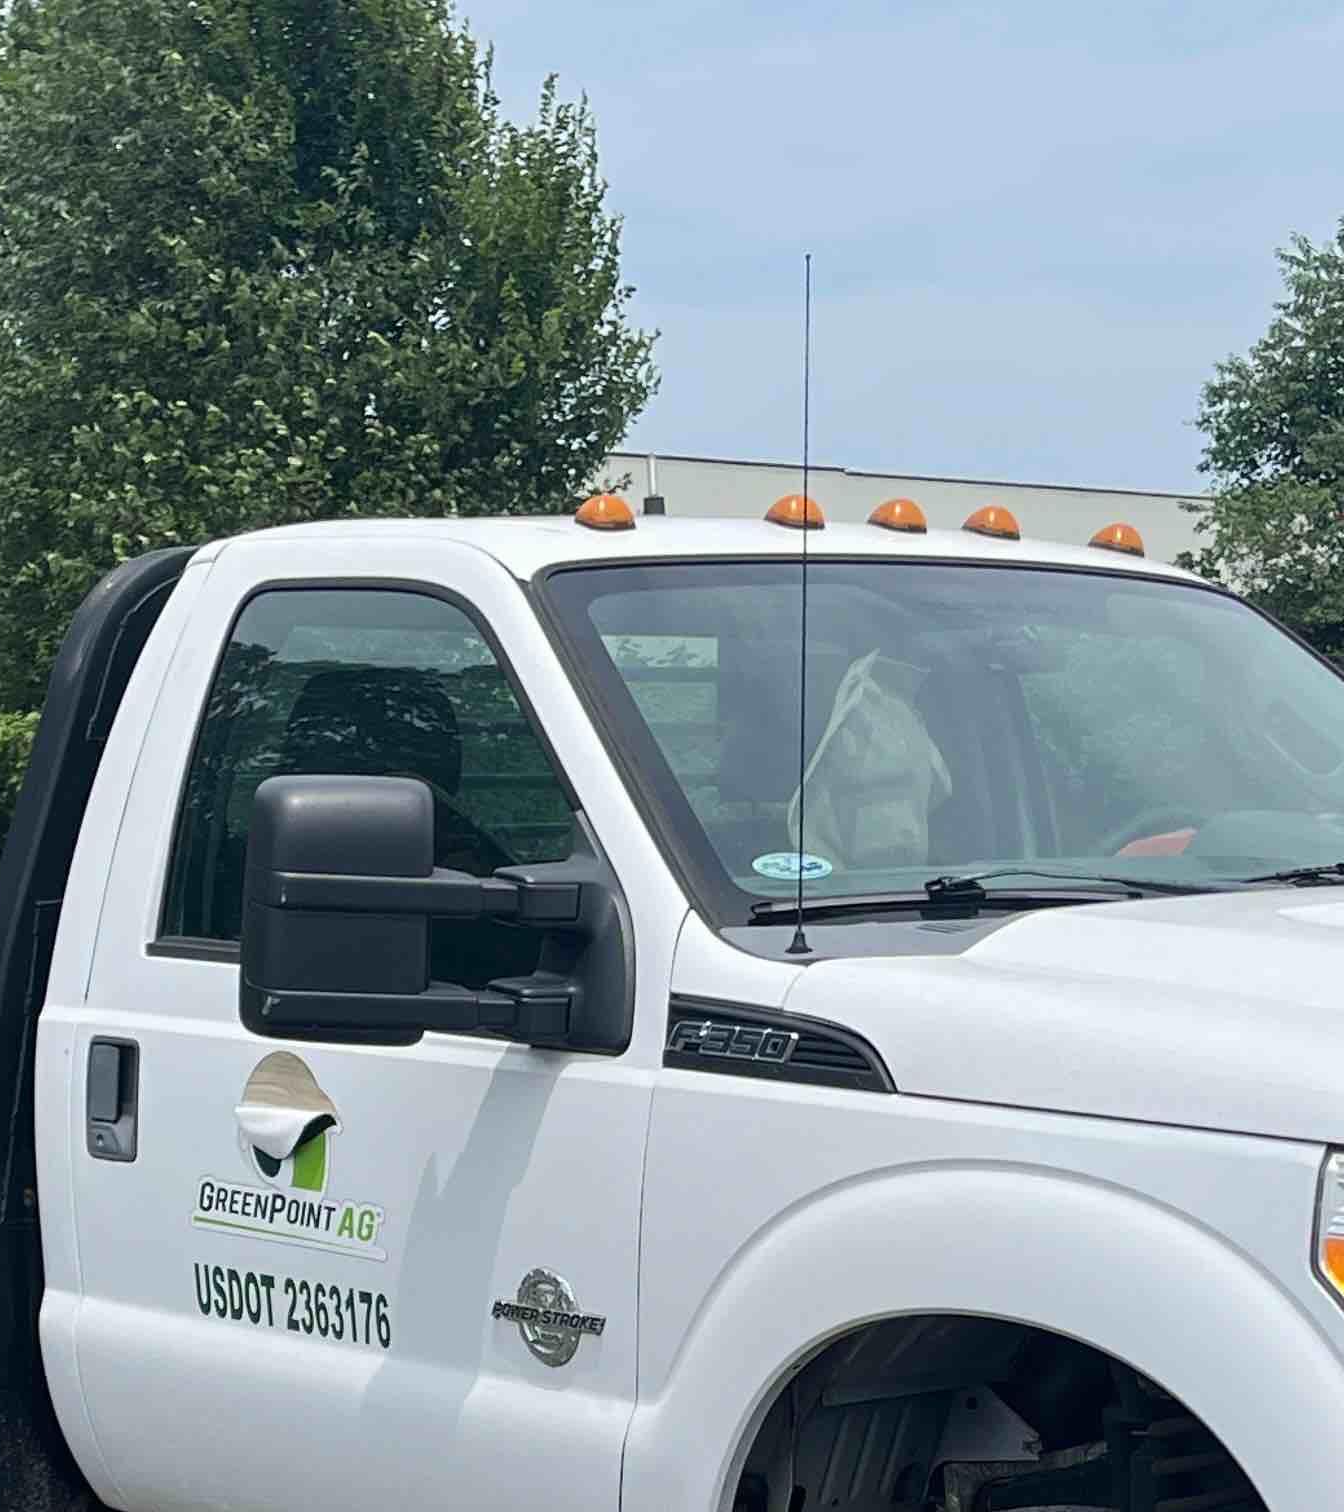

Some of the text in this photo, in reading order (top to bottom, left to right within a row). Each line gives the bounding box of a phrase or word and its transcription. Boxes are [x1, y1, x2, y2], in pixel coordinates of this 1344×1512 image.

[337, 1207, 376, 1242] AG
[194, 1263, 391, 1348] USDOT 2363176
